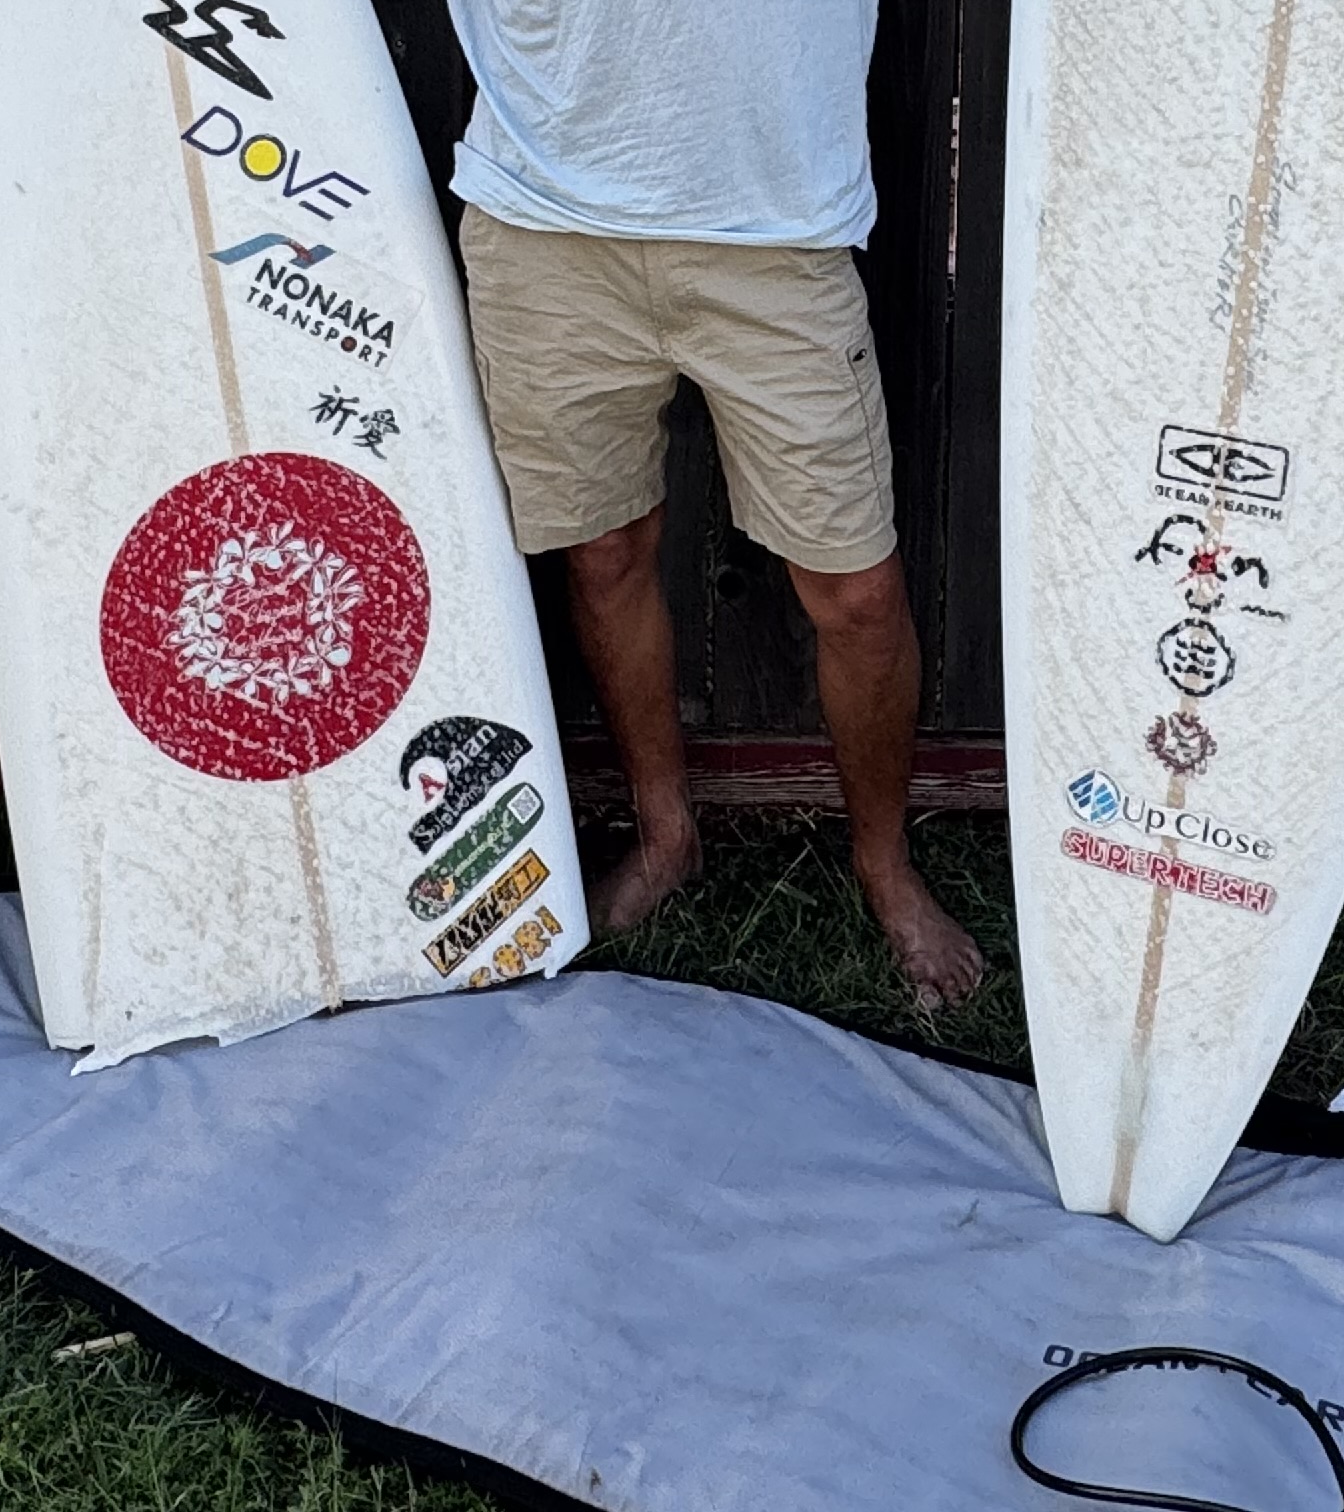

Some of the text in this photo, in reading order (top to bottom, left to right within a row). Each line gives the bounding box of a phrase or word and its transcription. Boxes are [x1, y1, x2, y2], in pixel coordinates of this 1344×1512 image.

[182, 105, 369, 222] DOVE
[244, 286, 389, 369] TRANSPORT
[254, 258, 396, 348] NONAKA
[1223, 500, 1283, 521] EARTH
[1122, 795, 1273, 859] Up Close
[1062, 828, 1276, 914] SUPERTECH
